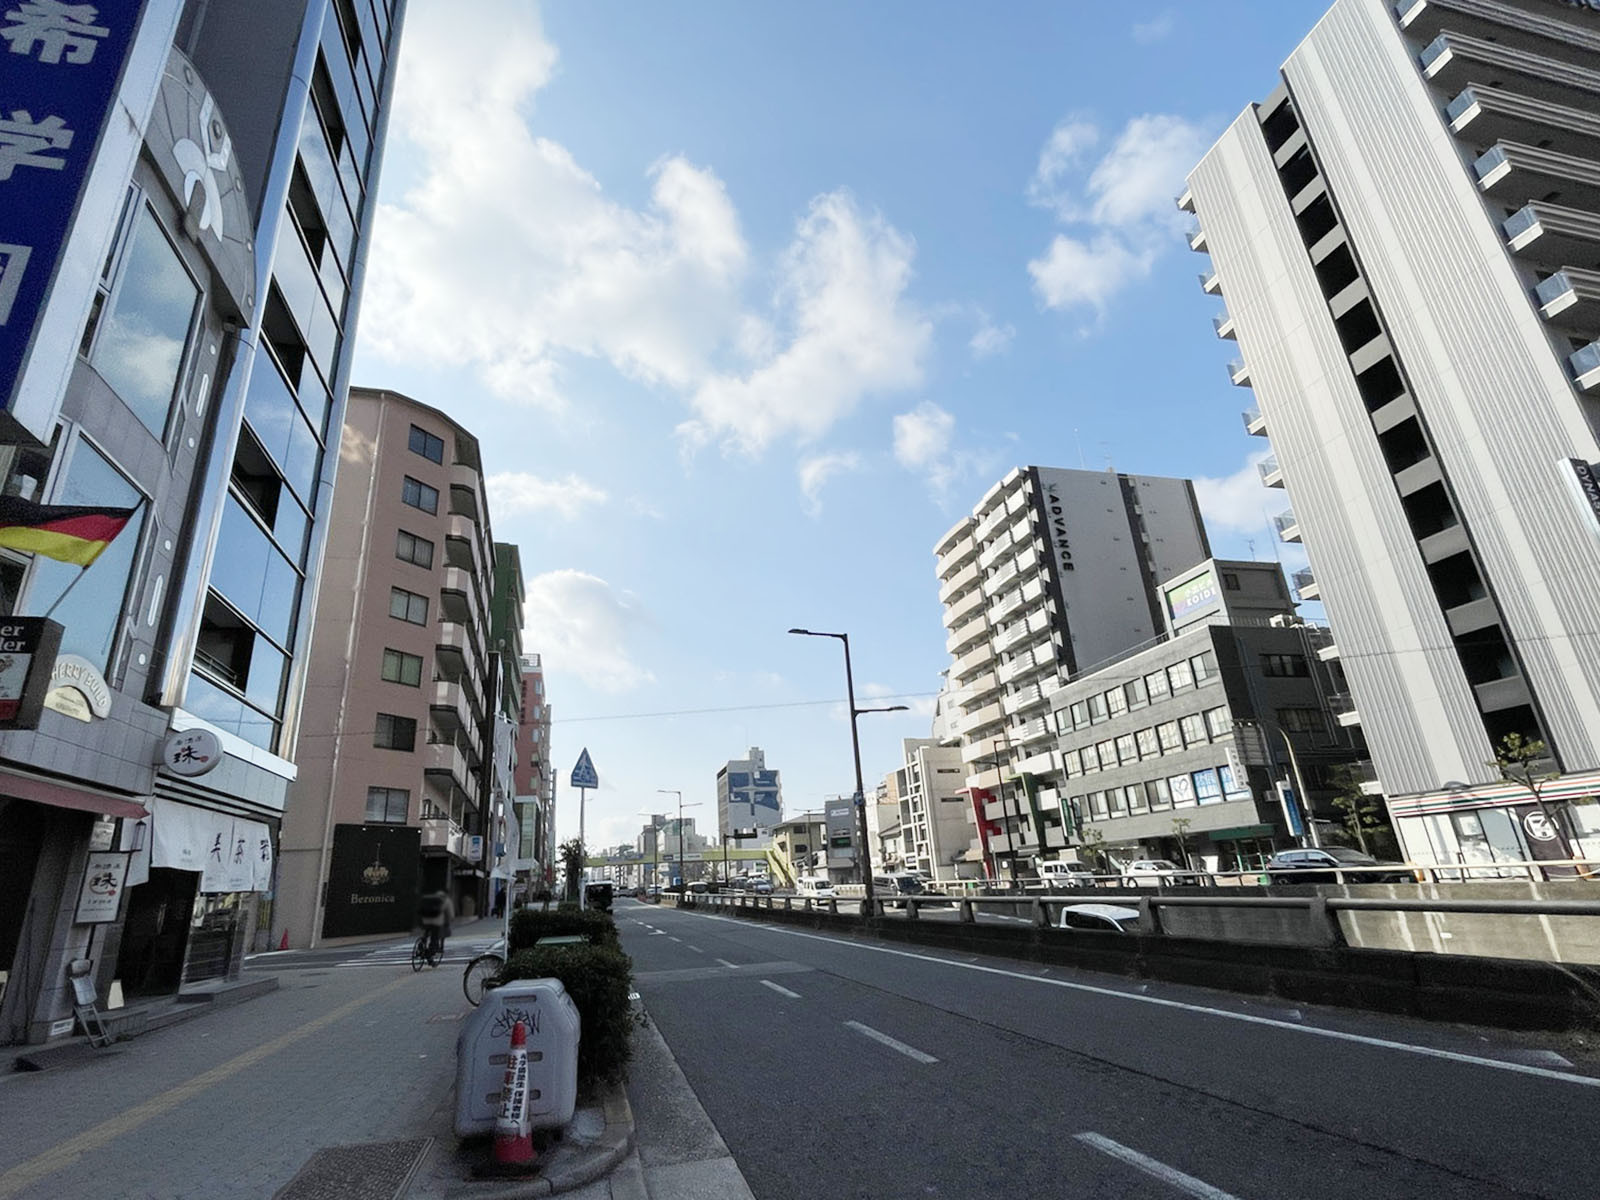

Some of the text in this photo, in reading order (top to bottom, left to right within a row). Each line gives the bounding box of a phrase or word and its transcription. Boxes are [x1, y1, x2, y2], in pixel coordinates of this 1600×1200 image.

[0, 0, 110, 326] 希学
[1049, 494, 1075, 571] ADVANCE
[350, 893, 396, 904] Beronica
